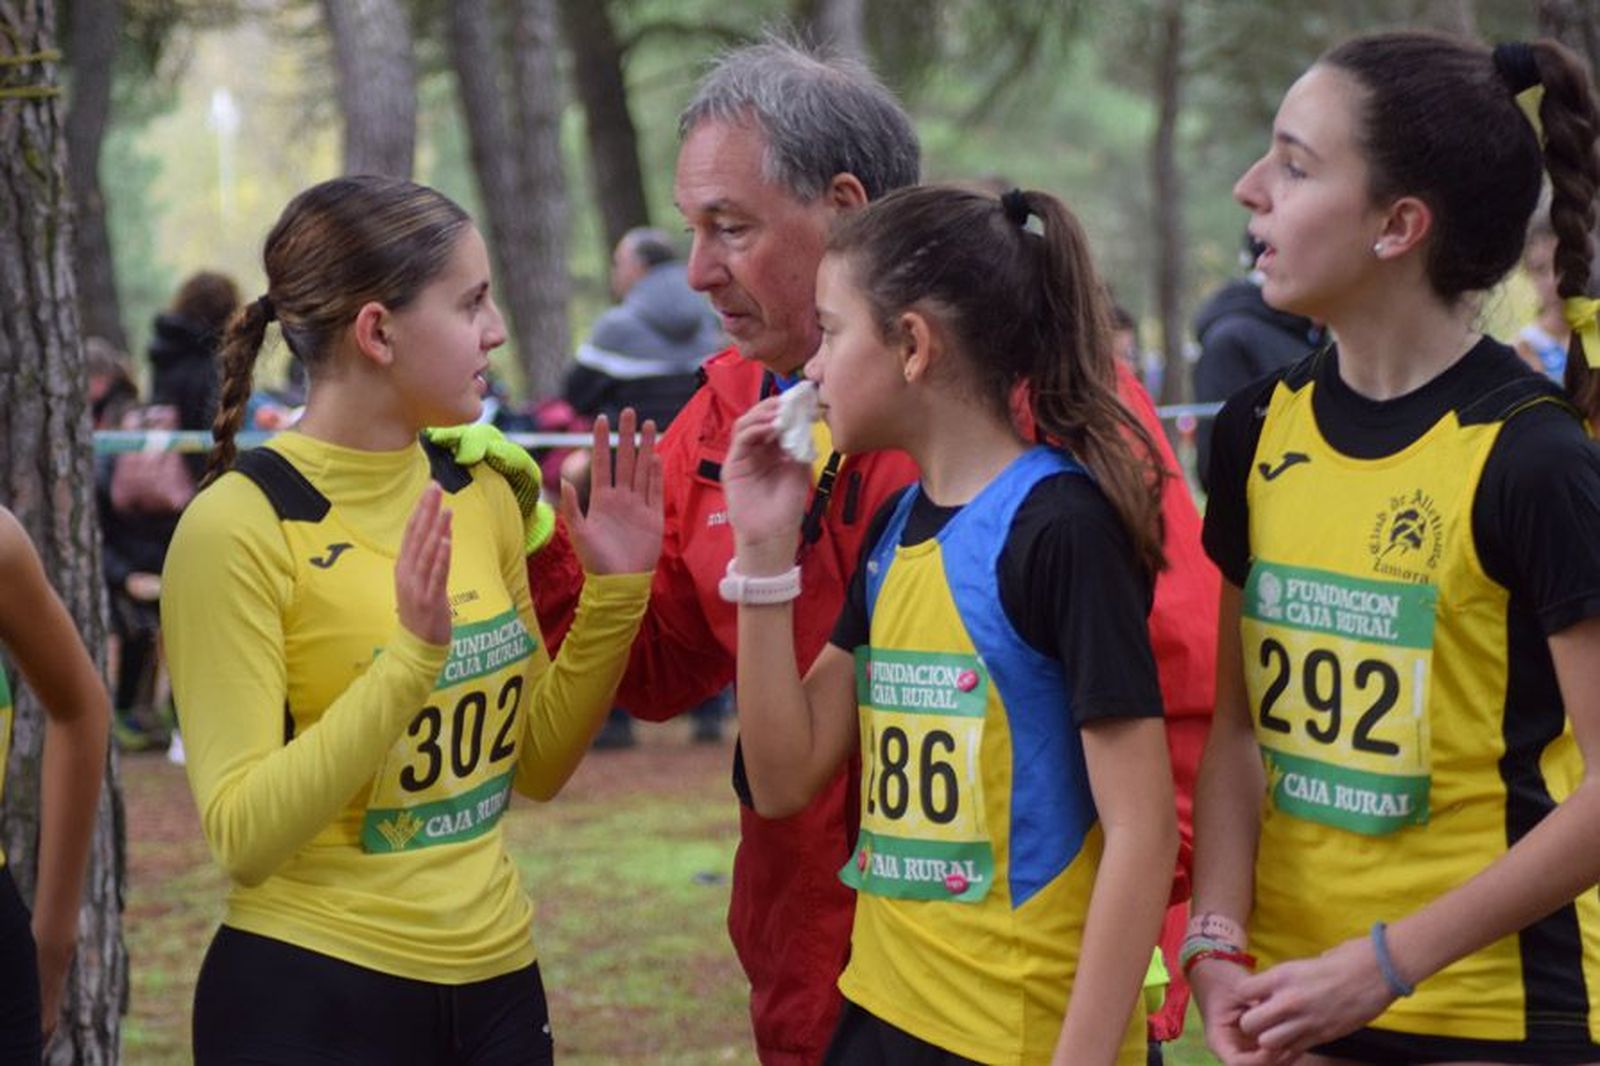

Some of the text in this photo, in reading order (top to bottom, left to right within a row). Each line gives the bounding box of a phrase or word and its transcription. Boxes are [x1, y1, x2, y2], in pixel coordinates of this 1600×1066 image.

[1373, 557, 1429, 584] Zamora
[1285, 578, 1401, 618] FUNDACION
[1286, 601, 1398, 640] CAJA RURAL
[444, 636, 529, 681] CAJA RURAL
[872, 661, 961, 688] FUNDACION
[902, 687, 958, 709] RURAL
[1260, 638, 1401, 757] 292
[400, 675, 524, 793] 302
[1284, 772, 1411, 818] CAJA RURAL
[425, 810, 474, 837] CAJA
[871, 853, 984, 884] AJA RURAL
